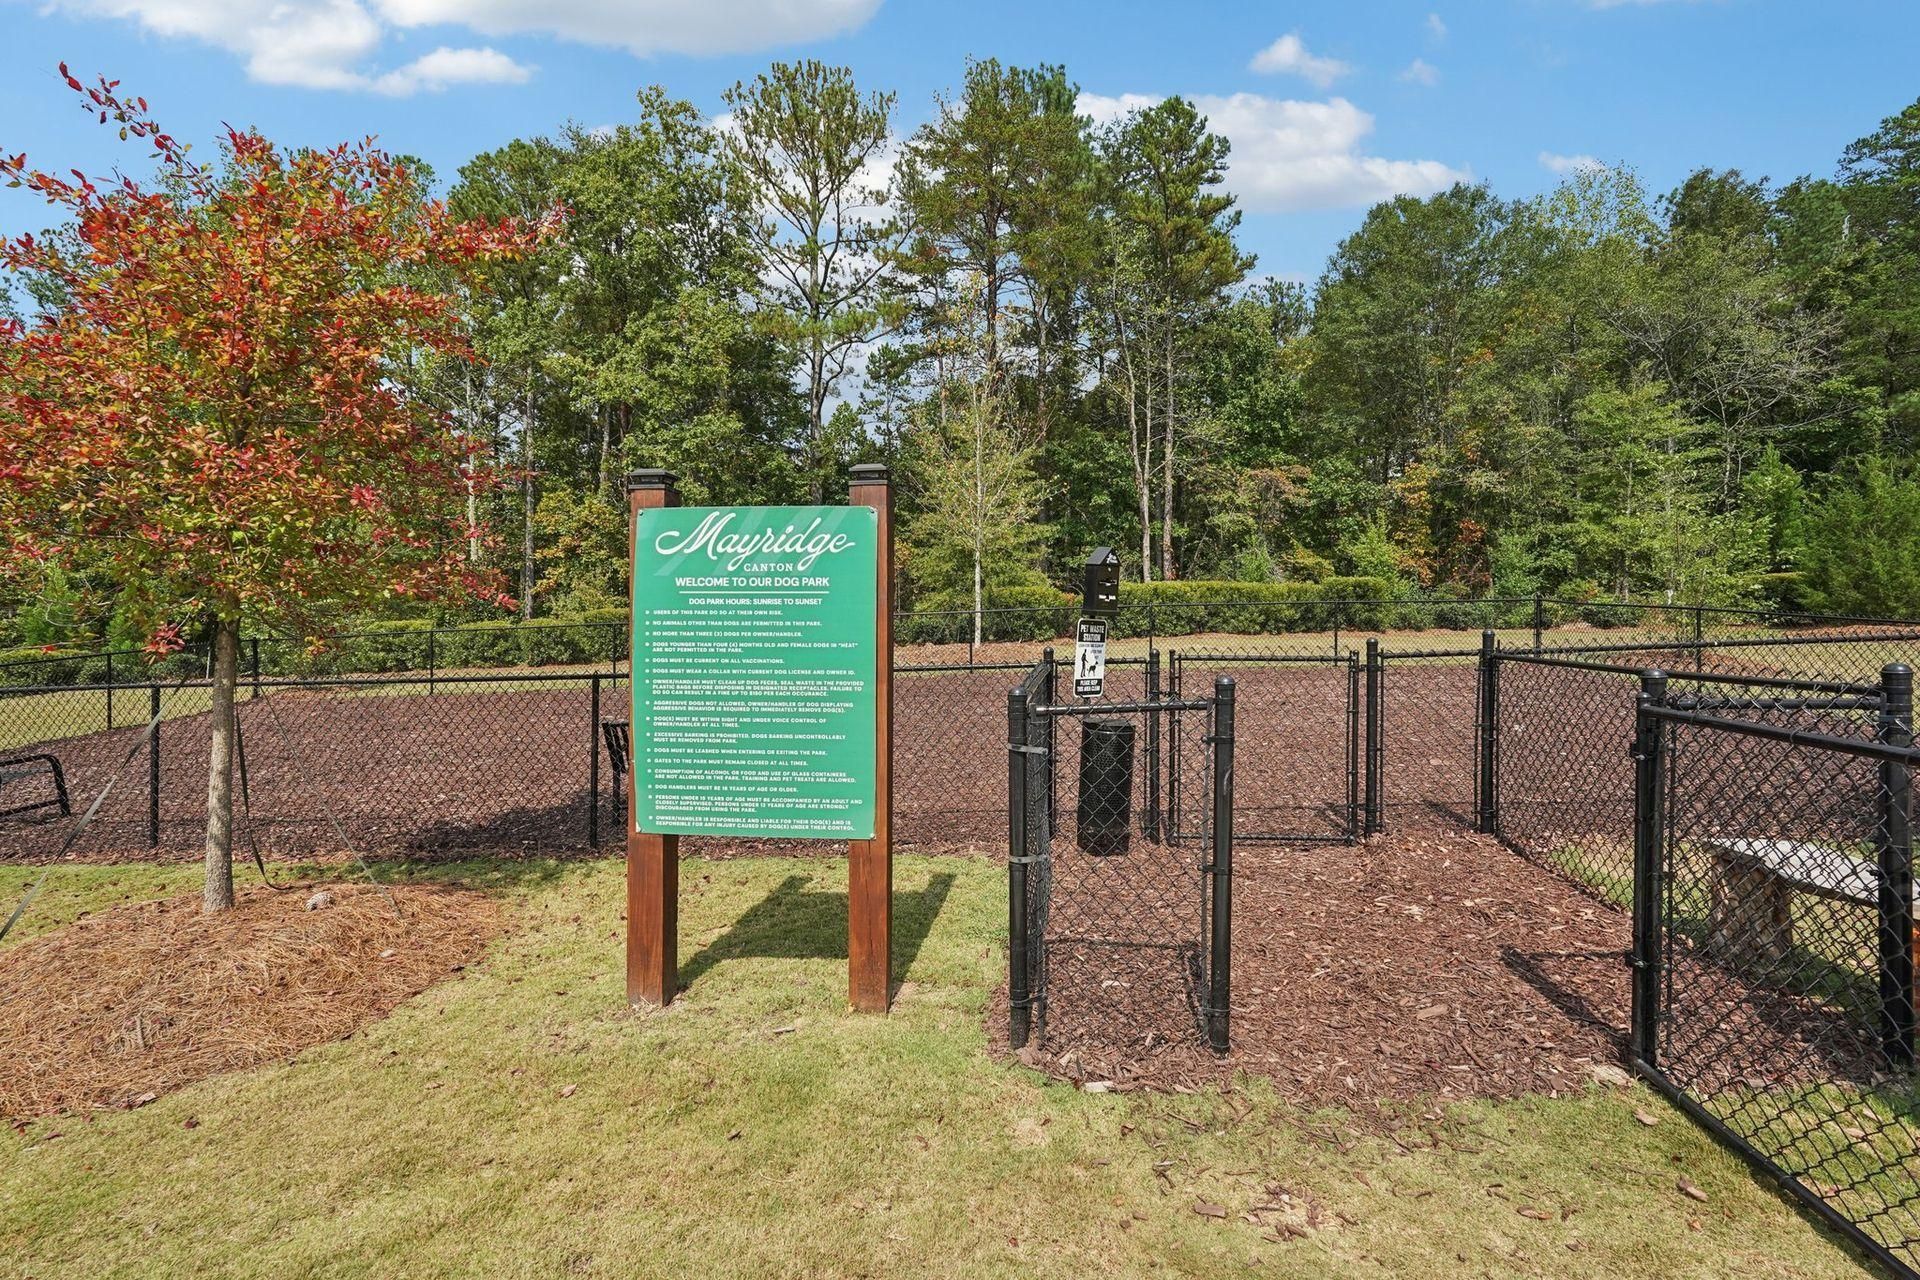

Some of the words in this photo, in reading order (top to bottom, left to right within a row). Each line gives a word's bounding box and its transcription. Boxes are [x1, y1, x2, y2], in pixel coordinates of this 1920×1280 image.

[655, 511, 856, 572] Mayridge
[744, 563, 793, 572] CANTON
[676, 577, 730, 586] WELCOME
[732, 577, 747, 586] TO
[749, 577, 772, 586] OUR
[774, 577, 800, 586] DOG
[802, 577, 829, 586] PARK
[1080, 624, 1089, 632] PET
[1090, 625, 1104, 633] WASTE
[1083, 633, 1101, 642] STATION
